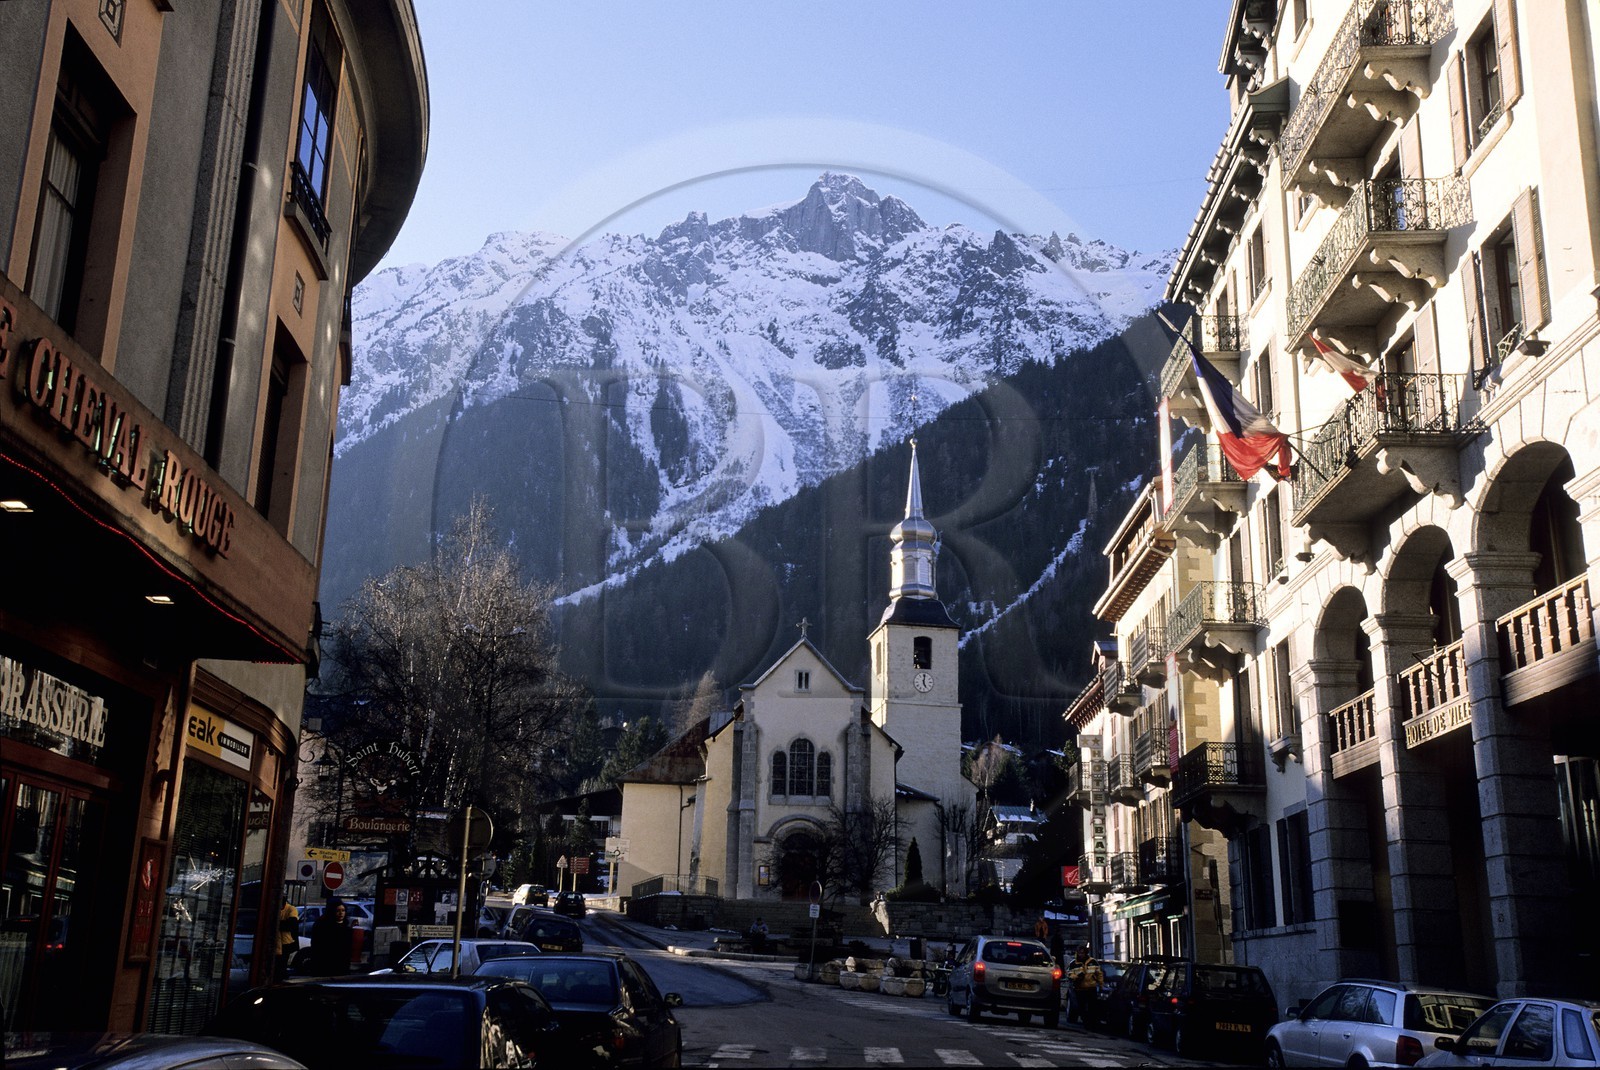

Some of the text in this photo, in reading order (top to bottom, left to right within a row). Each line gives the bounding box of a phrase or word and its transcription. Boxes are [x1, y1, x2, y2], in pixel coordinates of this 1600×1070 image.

[29, 336, 147, 490] CHEVAL
[159, 450, 237, 559] ROUGE
[188, 715, 216, 746] eak
[220, 735, 248, 755] IMMOBILIER
[1405, 719, 1431, 746] HOTEL
[1432, 711, 1446, 734] DE
[344, 740, 421, 777] Saint Hubert
[1092, 749, 1103, 817] HOTEL
[347, 817, 411, 834] Boulangerie
[1094, 826, 1105, 865] BAR
